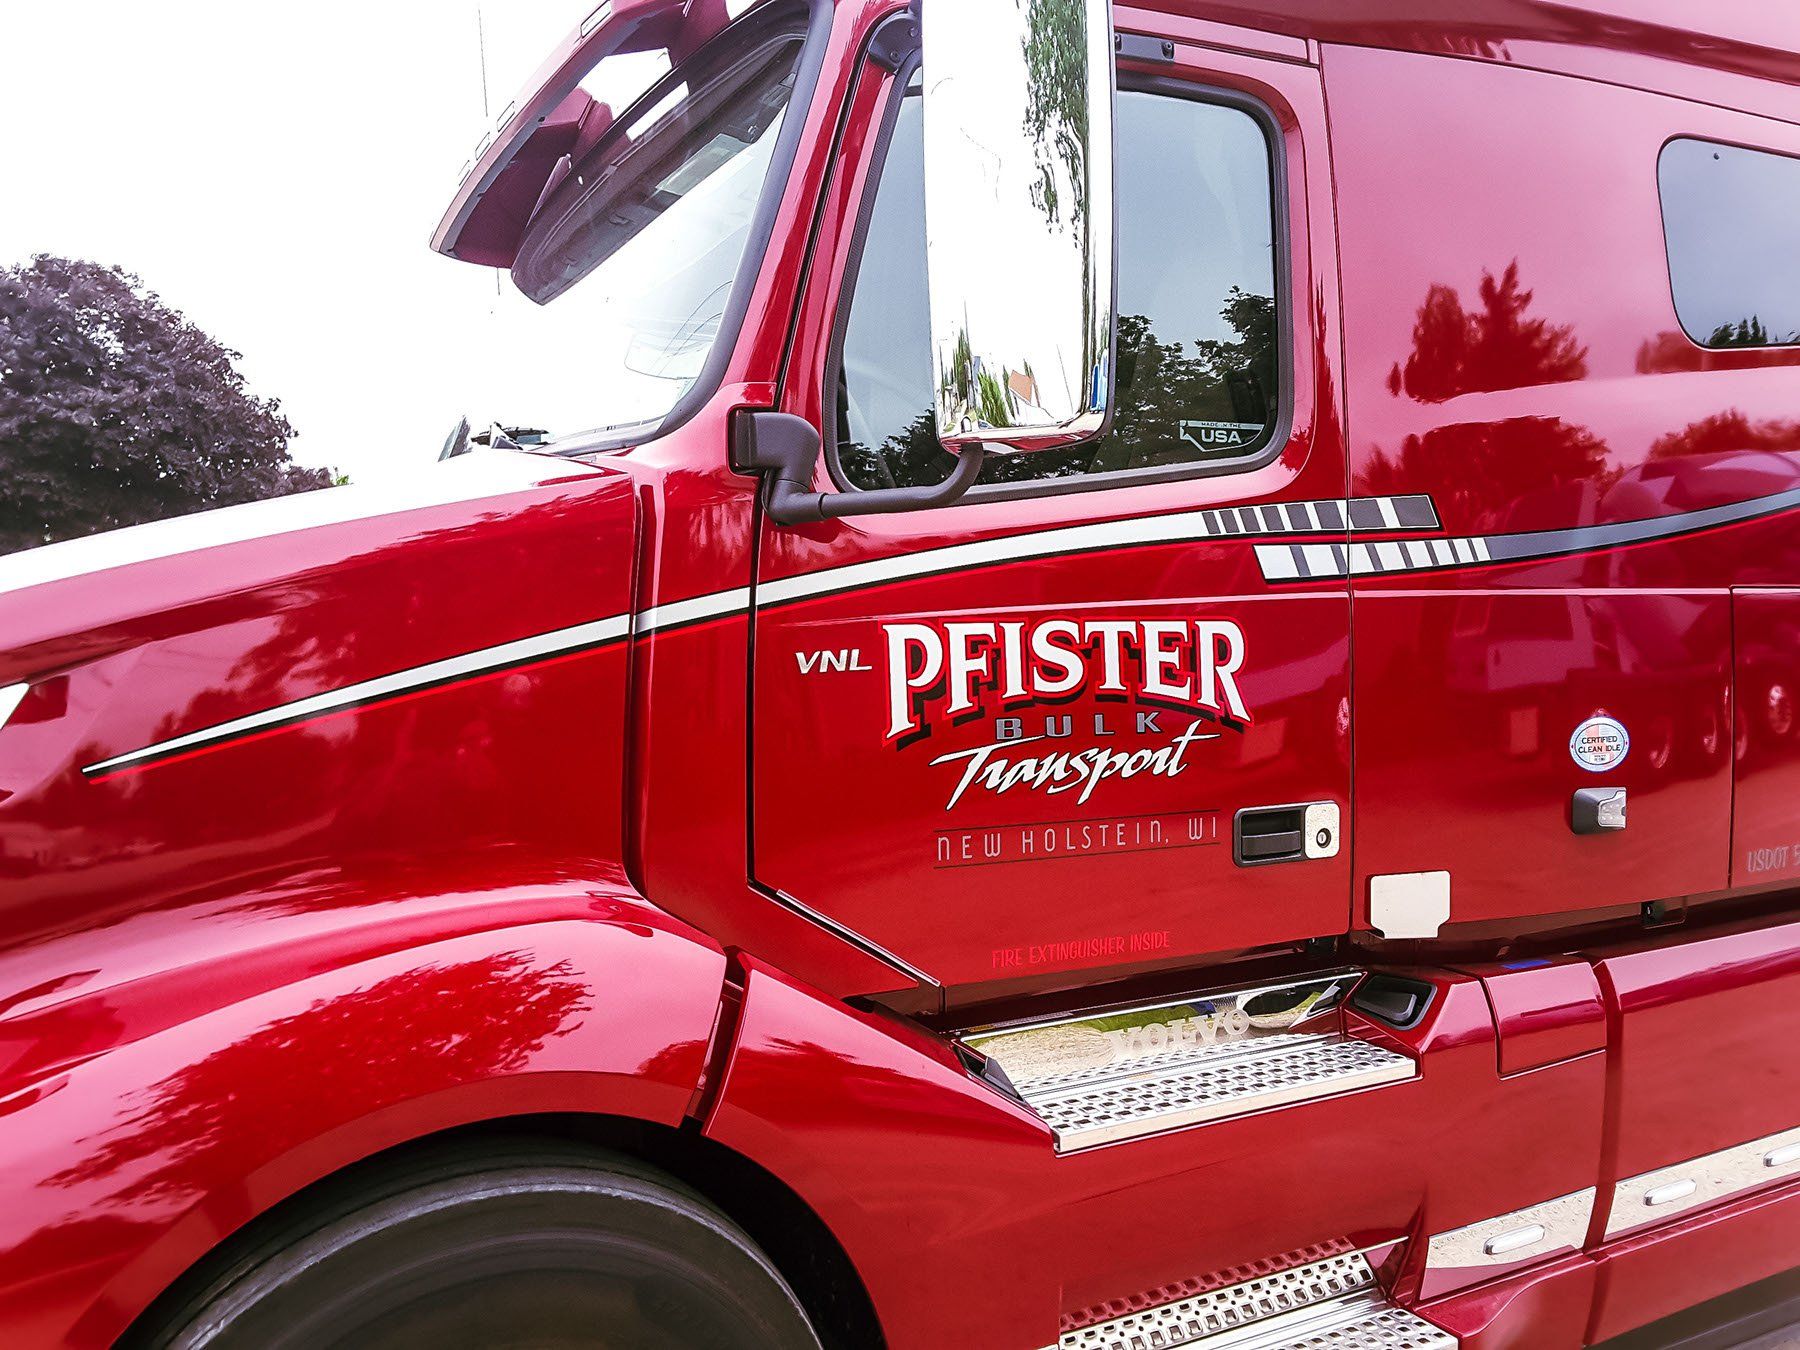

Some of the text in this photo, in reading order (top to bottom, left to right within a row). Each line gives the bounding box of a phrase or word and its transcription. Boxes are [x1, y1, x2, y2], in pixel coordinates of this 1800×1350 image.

[1201, 429, 1241, 443] USA
[795, 649, 873, 674] VNL
[881, 617, 1253, 740] PFISTER
[995, 711, 1162, 740] BULK
[1581, 736, 1618, 744] CERTIFIED
[1606, 744, 1621, 752] IDLE
[929, 719, 1221, 811] Transport
[938, 816, 1217, 861] NEW HOLSTEIN, WI
[1747, 846, 1789, 872] USDOT
[991, 931, 1170, 969] FIRE EXTINGUISHER INSIDE
[1103, 1009, 1250, 1052] VOLVO
